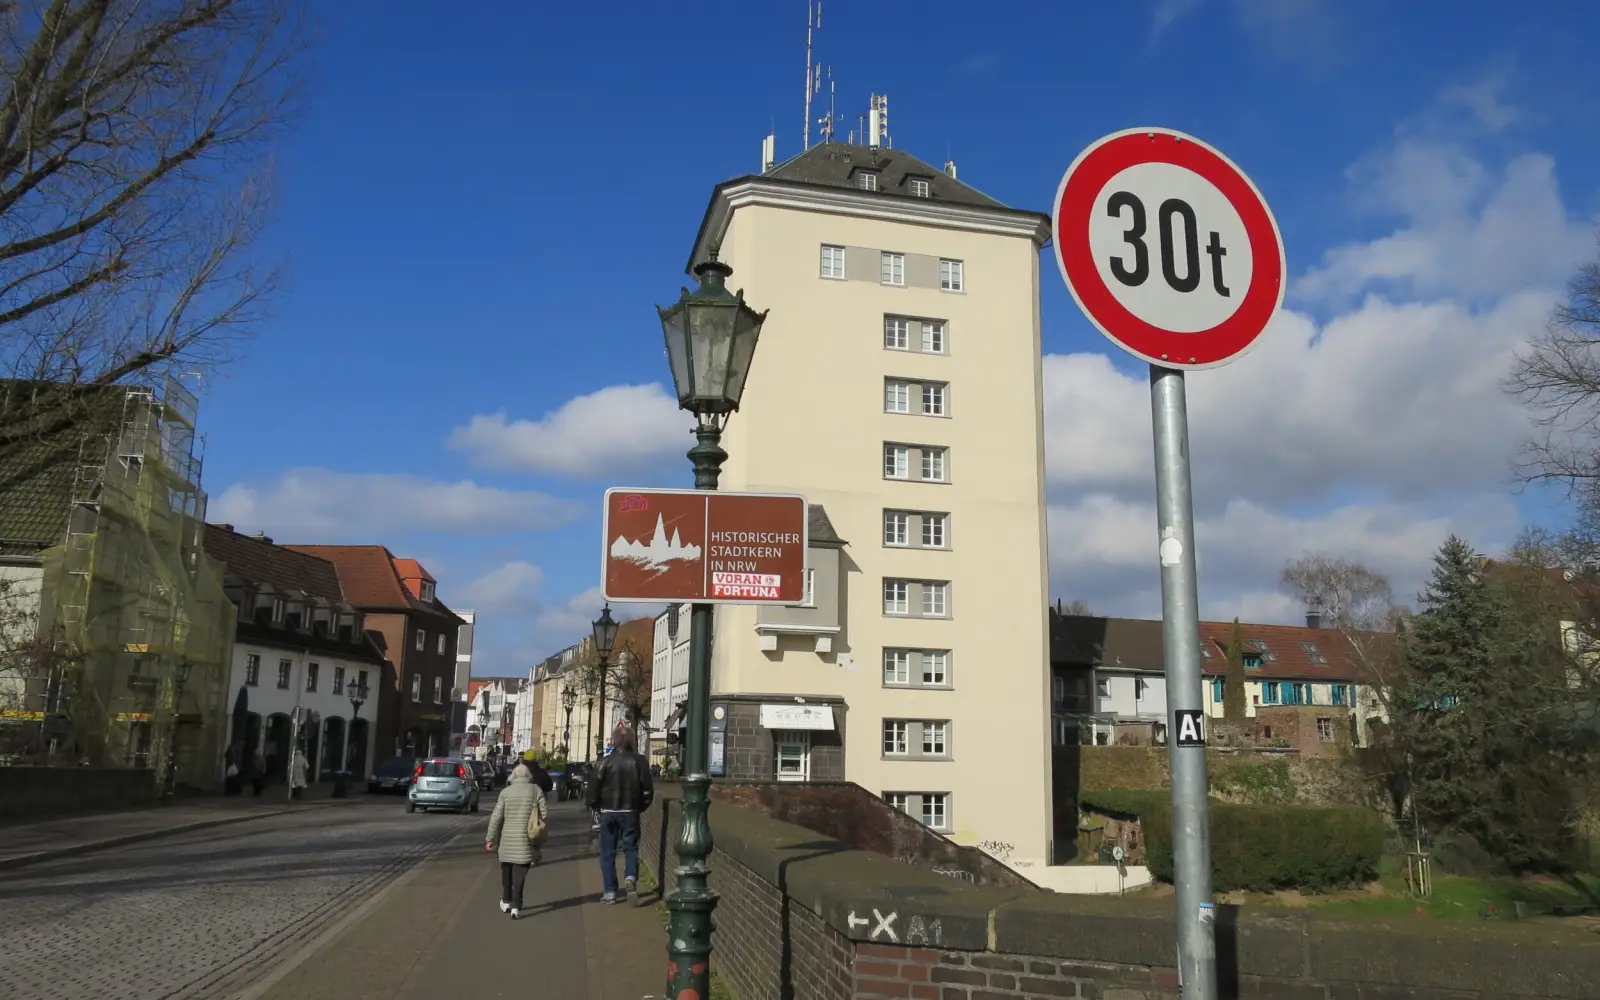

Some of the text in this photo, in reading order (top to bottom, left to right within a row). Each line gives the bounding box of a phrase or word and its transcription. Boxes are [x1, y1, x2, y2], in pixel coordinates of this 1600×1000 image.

[1107, 191, 1231, 298] 30t
[711, 531, 800, 544] HISTORISCHER
[710, 546, 782, 558] STADTKERN
[710, 560, 757, 572] IN NRW
[716, 573, 762, 585] VORAN
[713, 585, 779, 598] FORTUNA
[1179, 713, 1205, 741] A1
